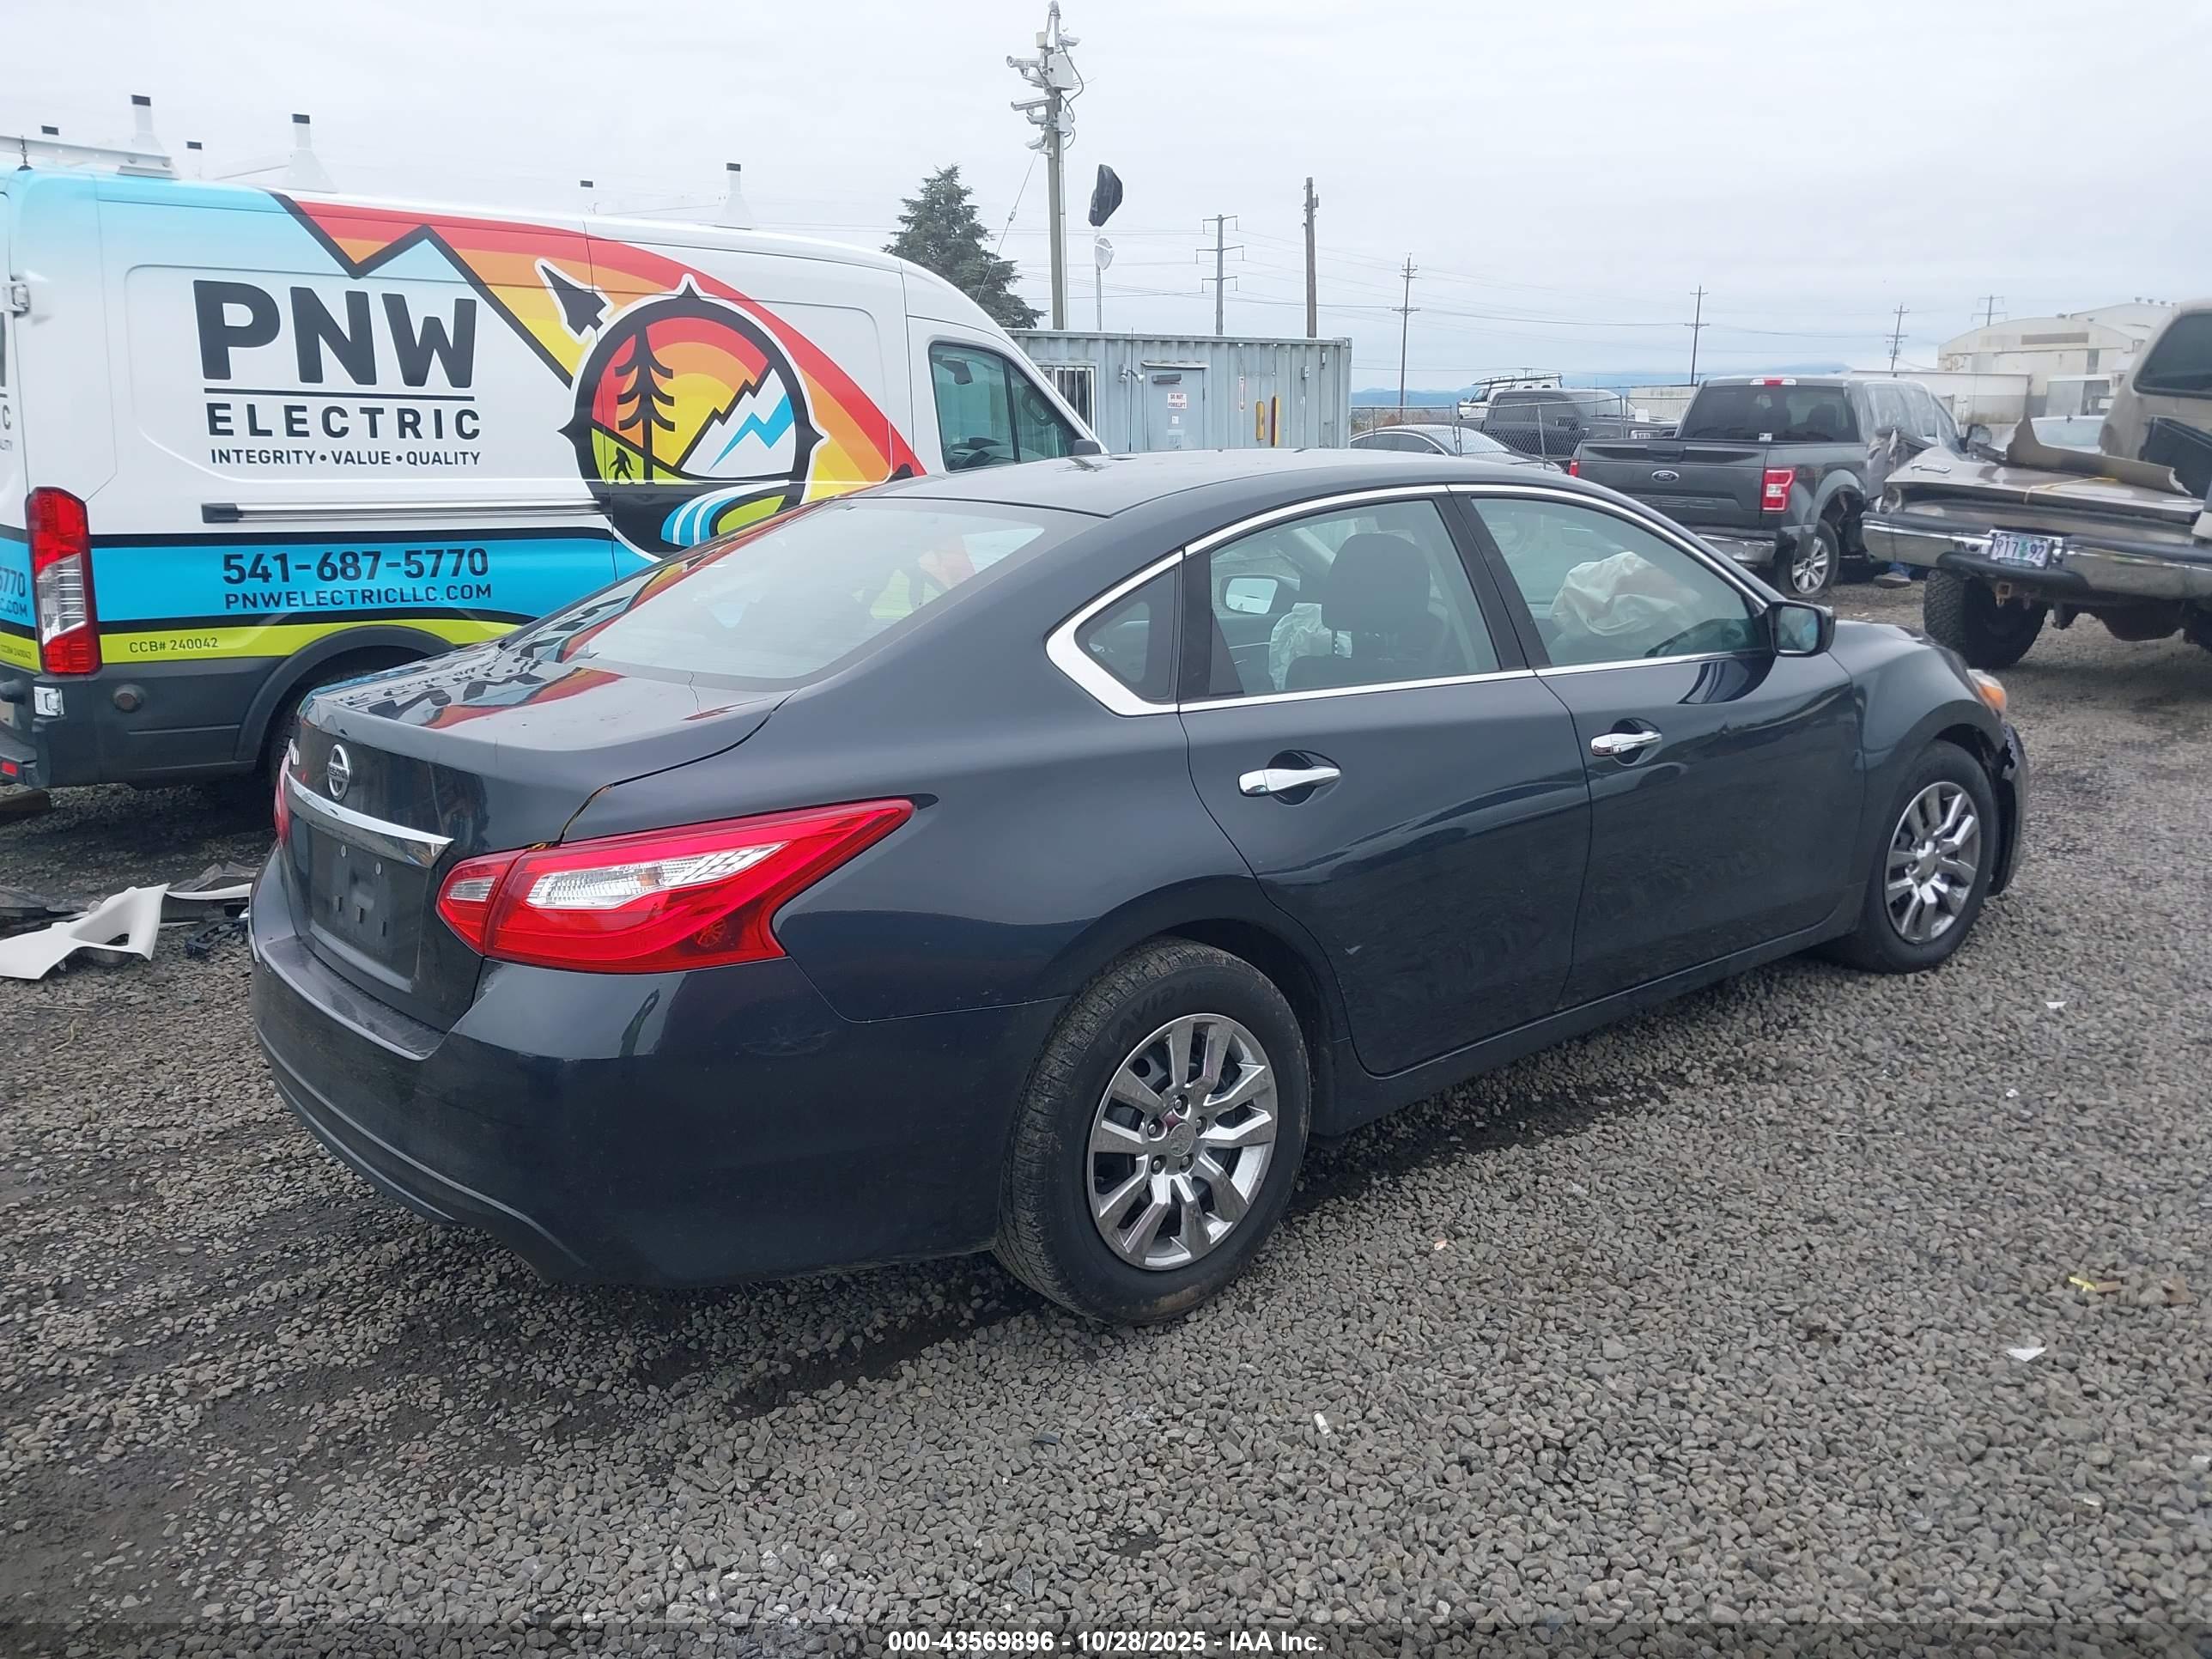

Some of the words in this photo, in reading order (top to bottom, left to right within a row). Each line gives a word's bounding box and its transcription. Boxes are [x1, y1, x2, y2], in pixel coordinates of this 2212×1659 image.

[193, 280, 477, 388] PNW
[206, 403, 480, 440] ELECTRIC
[222, 548, 488, 585] 541-687-5770
[225, 583, 492, 610] PNWELECTRICLLC.COM
[129, 641, 167, 653] CCB#
[170, 637, 219, 650] 240042
